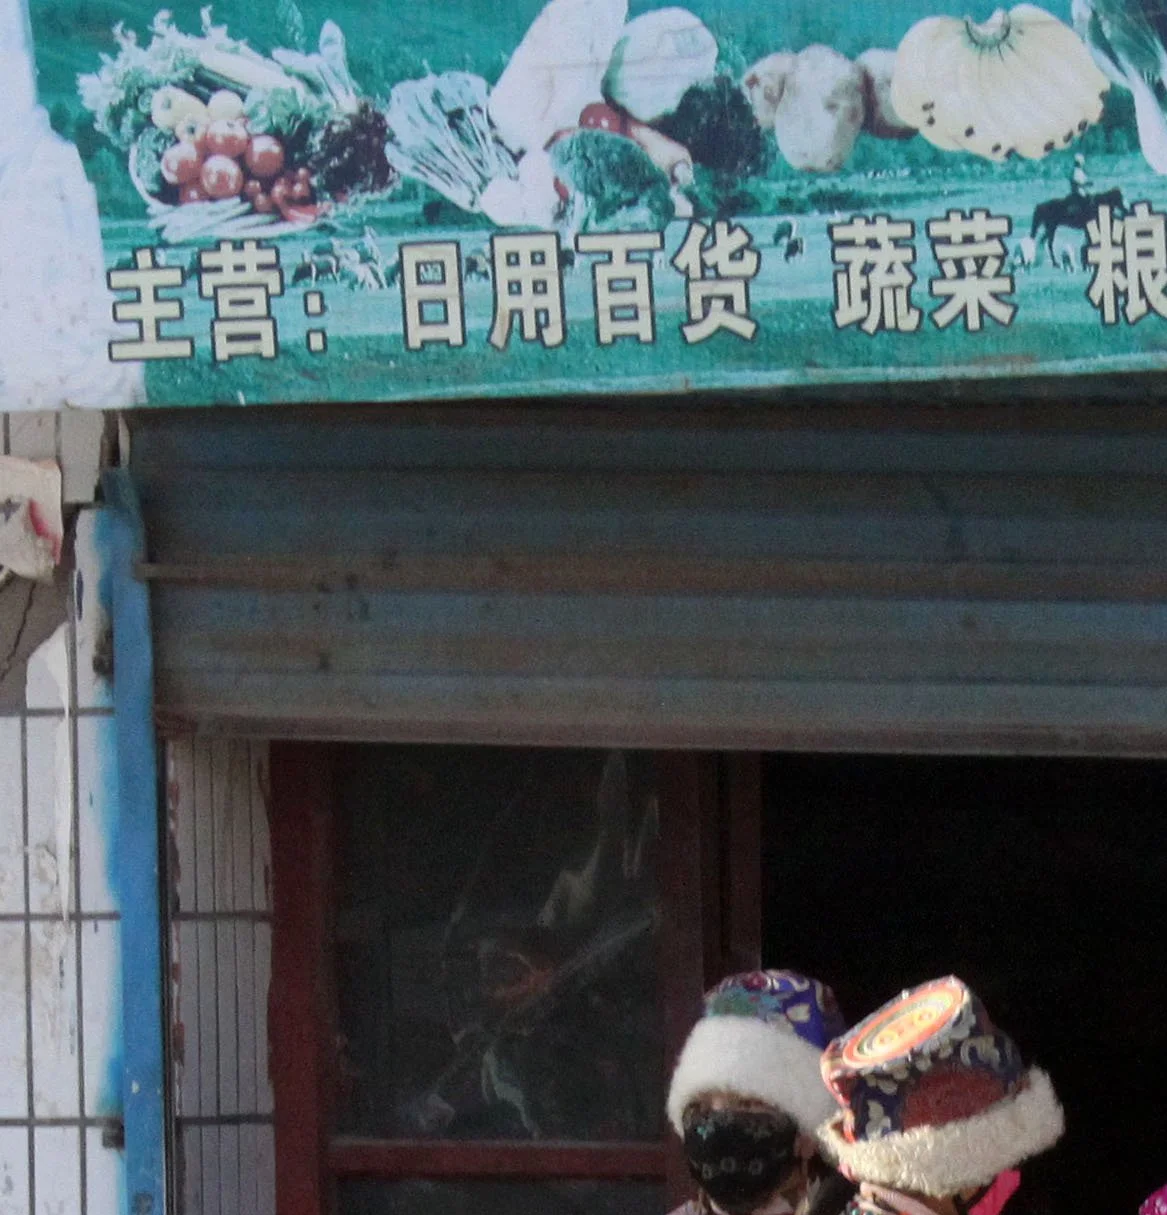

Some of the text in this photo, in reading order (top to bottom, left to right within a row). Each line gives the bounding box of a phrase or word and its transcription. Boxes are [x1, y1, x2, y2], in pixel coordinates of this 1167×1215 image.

[399, 220, 762, 350] 日用百货
[829, 208, 1017, 335] 蔬菜
